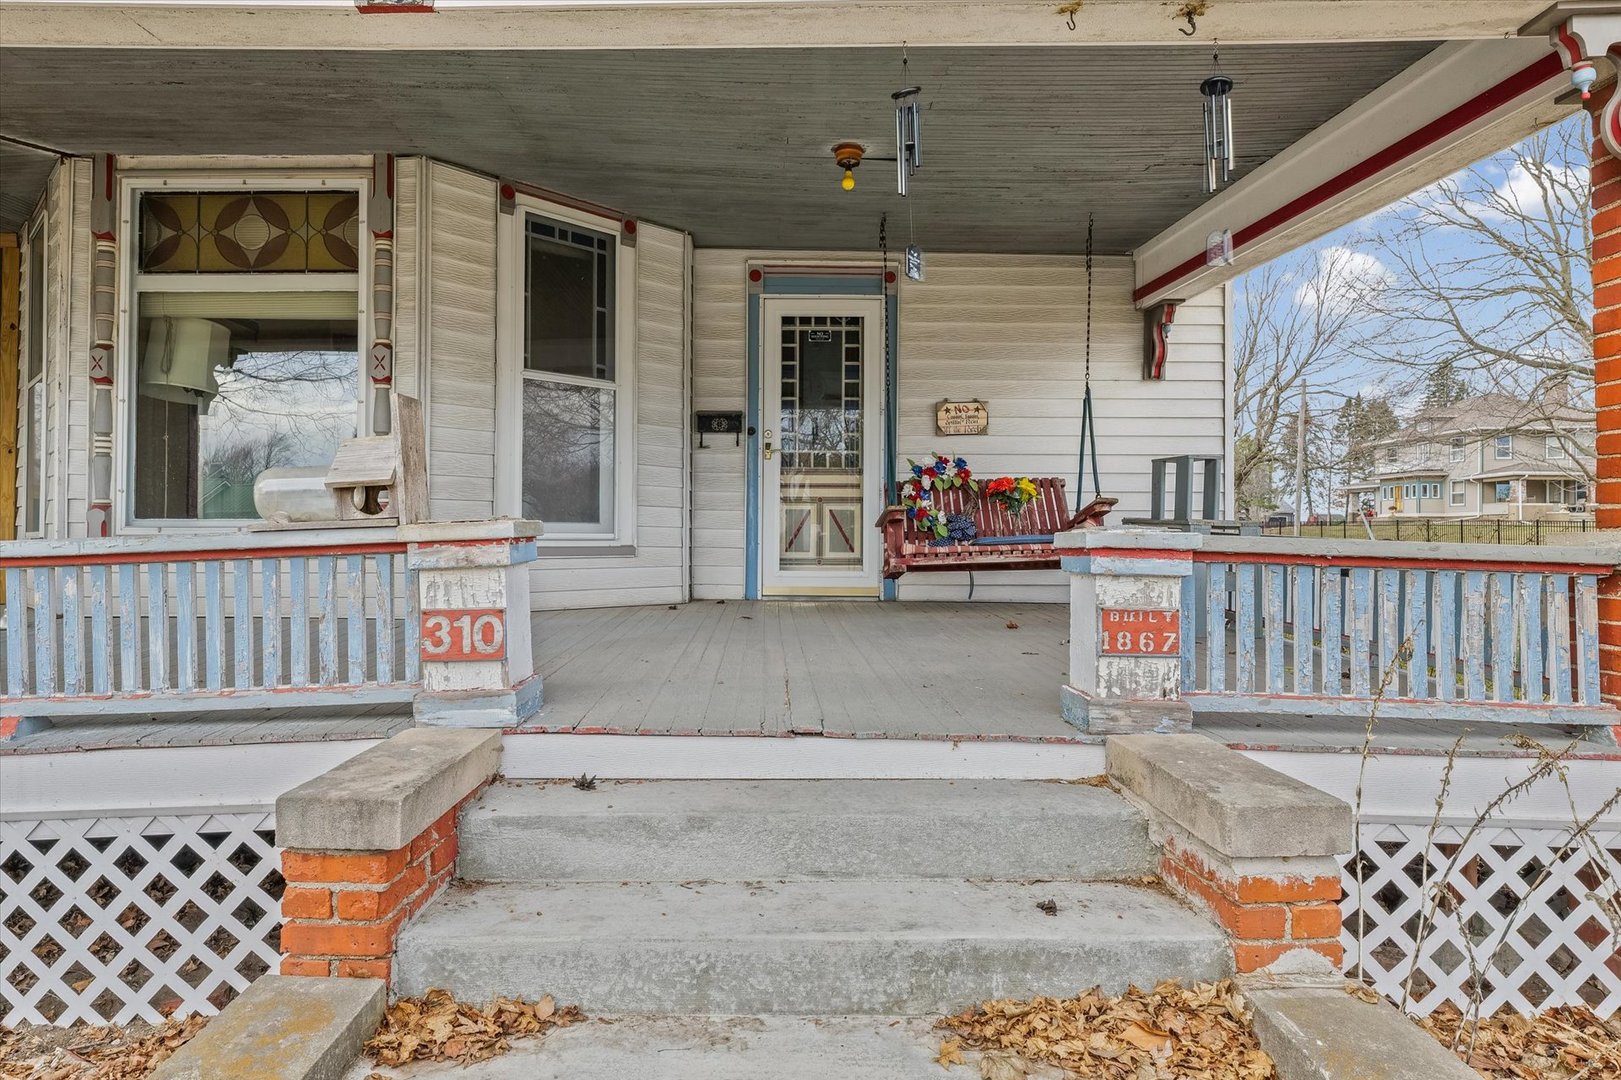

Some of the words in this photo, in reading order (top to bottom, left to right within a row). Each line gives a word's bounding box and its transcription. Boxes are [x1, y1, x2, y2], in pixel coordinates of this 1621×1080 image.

[954, 404, 970, 415] NO
[1110, 611, 1172, 622] BUILT
[423, 614, 504, 655] 310
[1102, 630, 1177, 652] 1867
